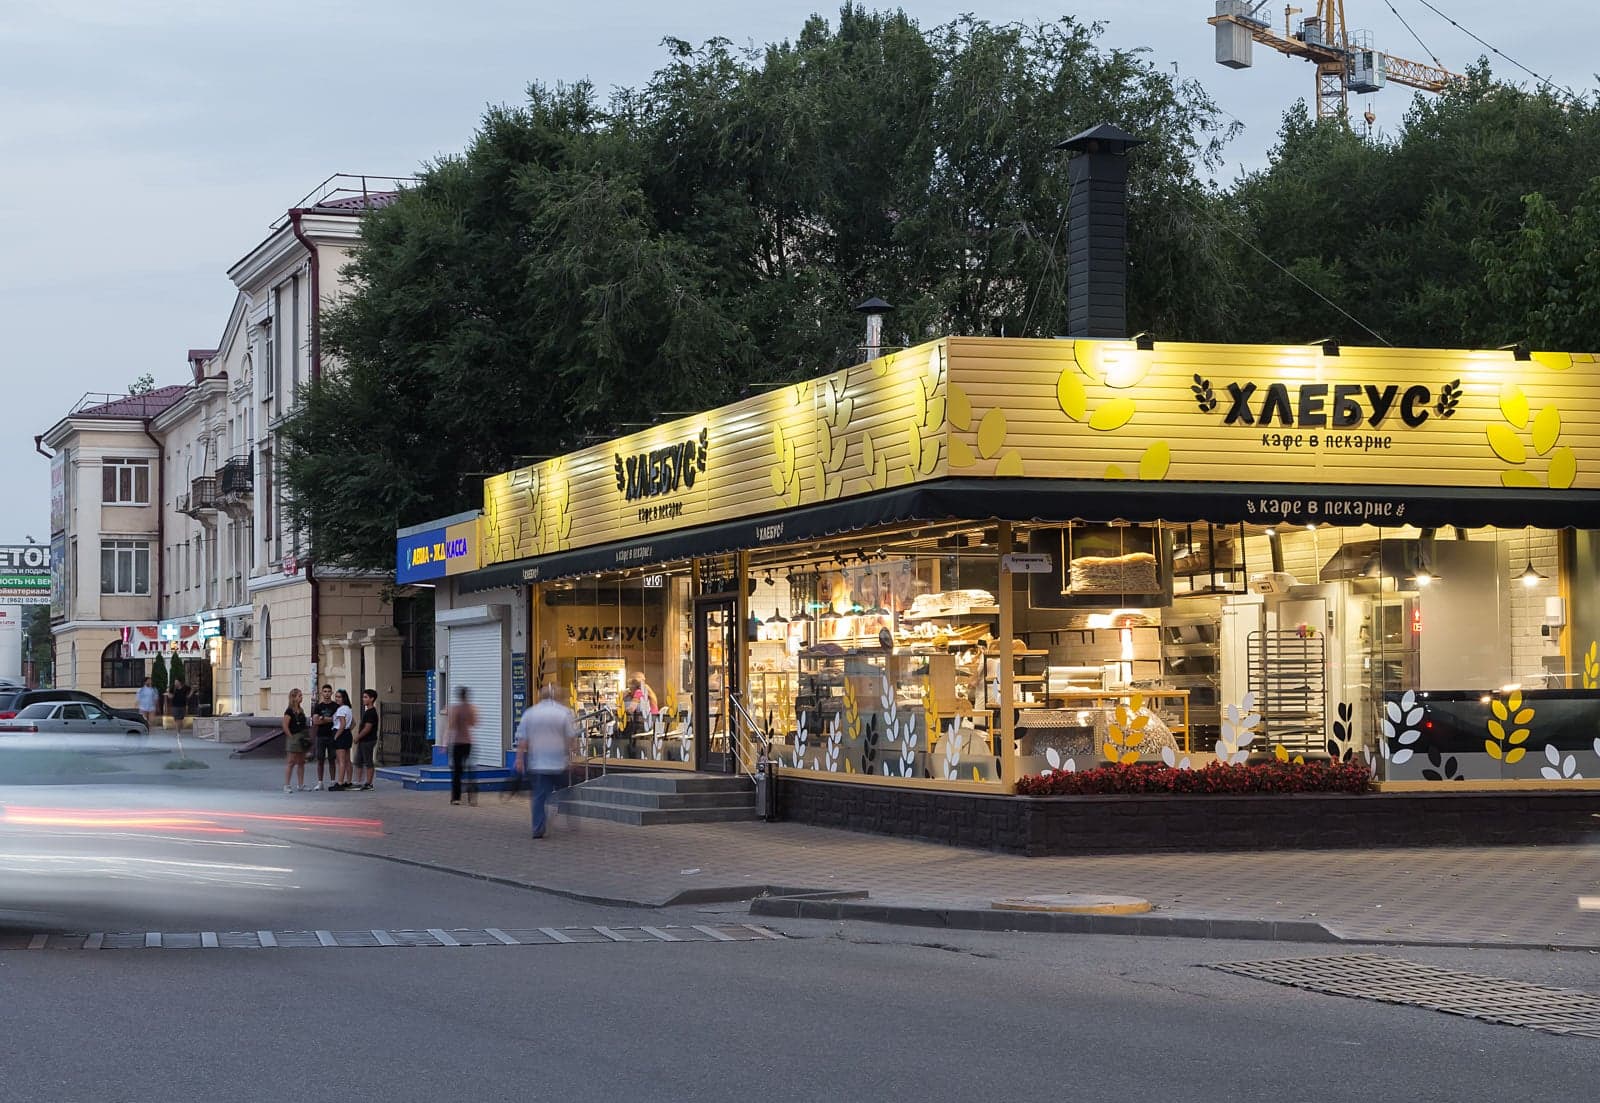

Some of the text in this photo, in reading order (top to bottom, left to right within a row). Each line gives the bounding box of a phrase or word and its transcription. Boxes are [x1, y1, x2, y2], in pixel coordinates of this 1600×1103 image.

[1223, 381, 1431, 429] ХЛЕБУС
[1262, 433, 1392, 452] кафе в пекарне
[625, 440, 696, 502] ХЛЕБУС
[1260, 499, 1392, 519] кафе в пекарне
[446, 537, 467, 559] КАССА
[577, 626, 648, 642] ХЛЕБУС
[138, 640, 200, 651] АПТЕКА
